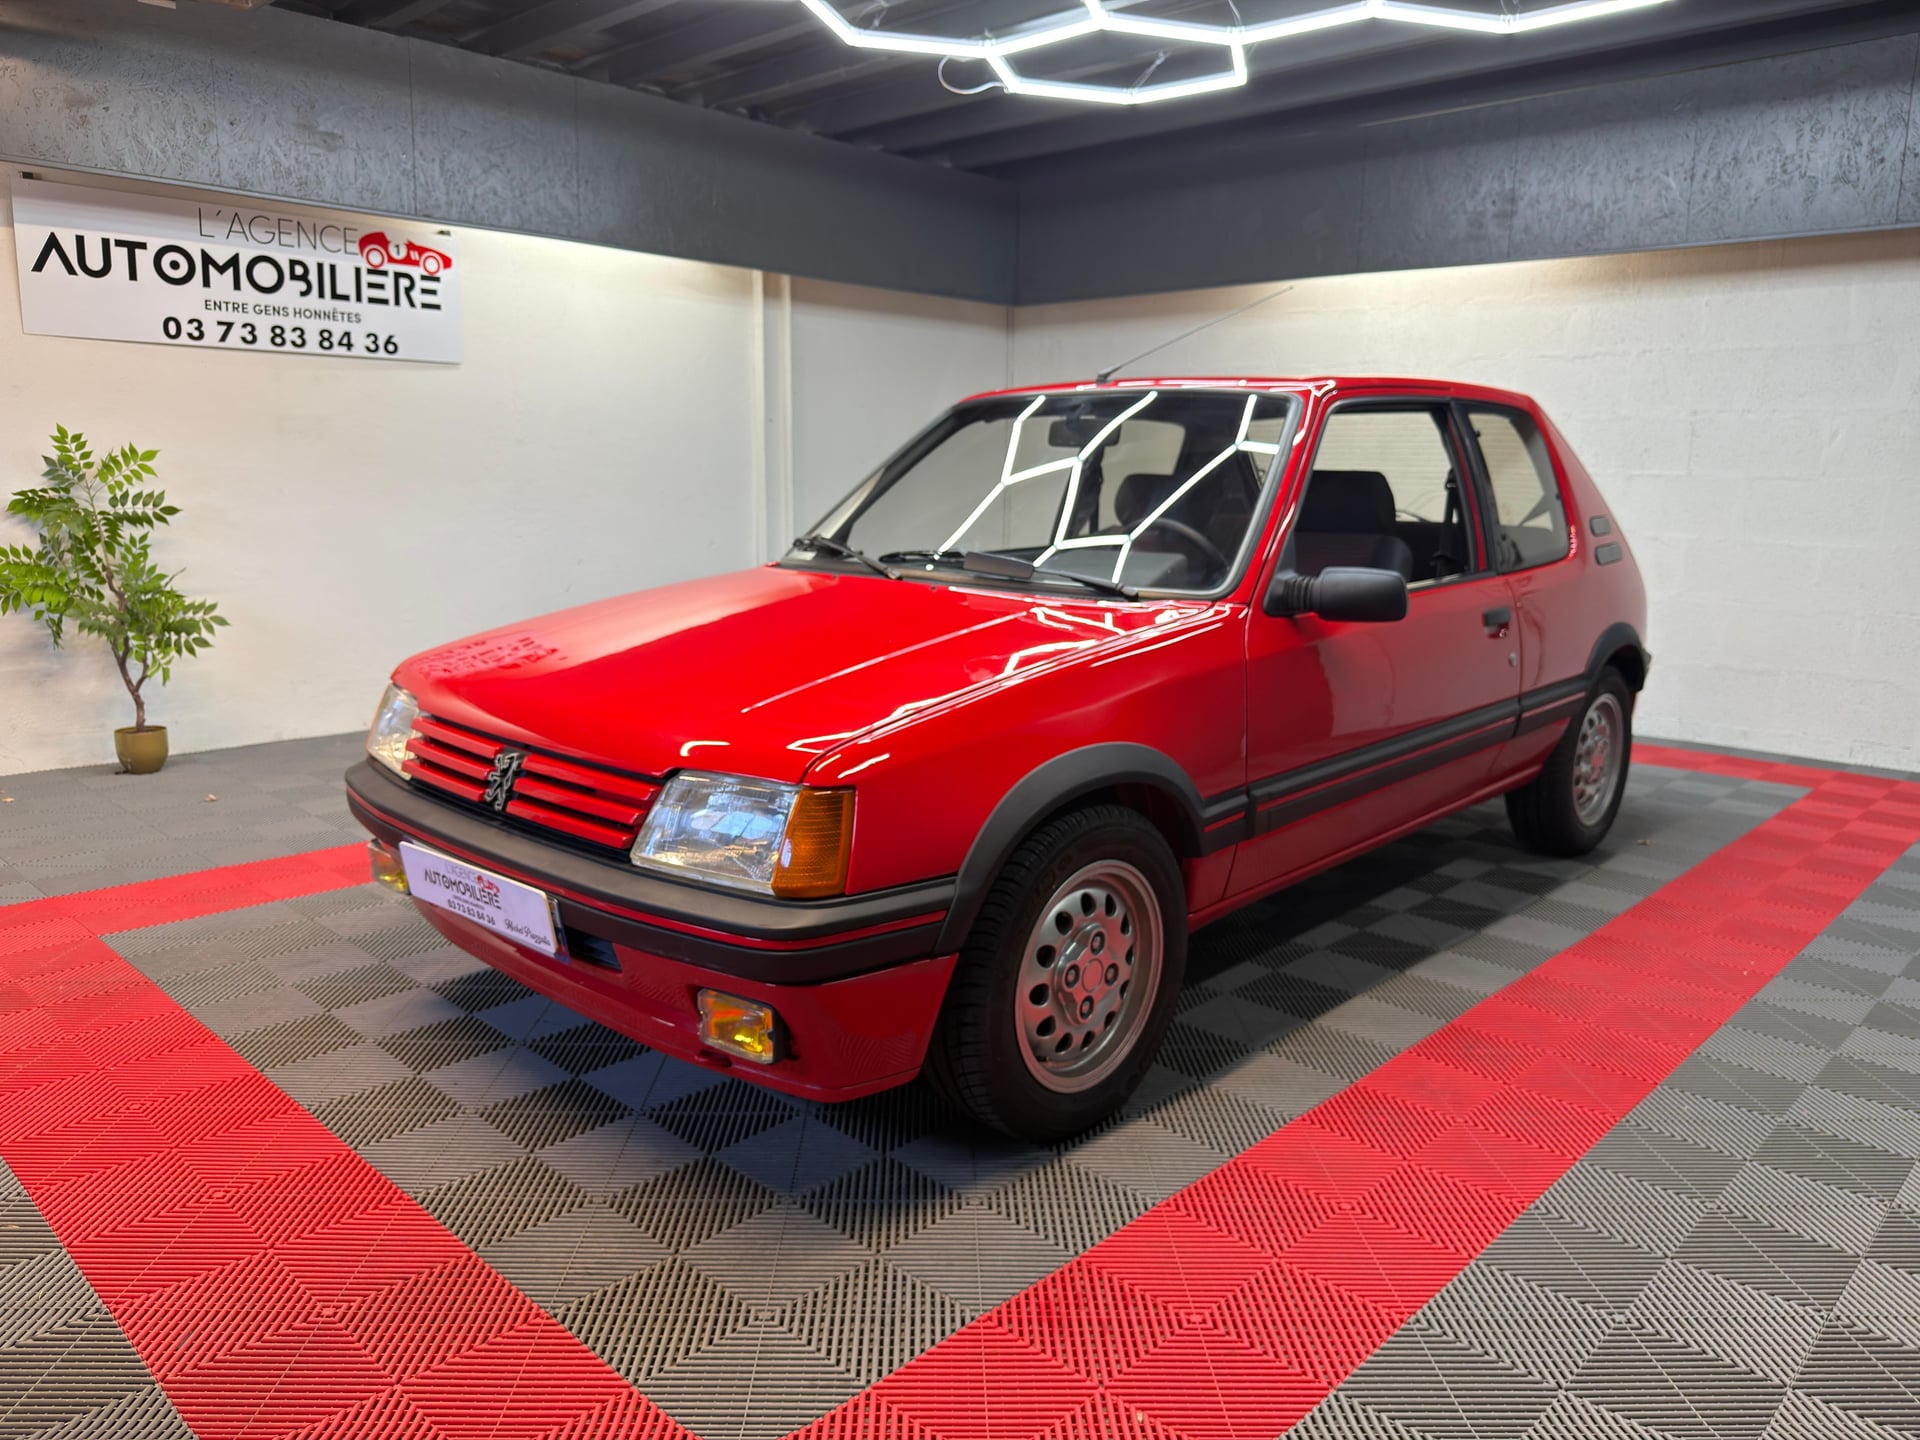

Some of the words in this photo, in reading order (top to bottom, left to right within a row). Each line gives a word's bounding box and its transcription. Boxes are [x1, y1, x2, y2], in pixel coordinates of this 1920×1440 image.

[198, 207, 359, 256] L'AGENCE
[204, 299, 248, 314] ENTRE
[252, 304, 290, 317] GENS
[293, 307, 362, 324] HONNÊTES
[163, 316, 205, 341] 03
[217, 320, 258, 344] 73
[270, 325, 306, 348] 83
[318, 329, 354, 351] 84
[365, 333, 399, 354] 36
